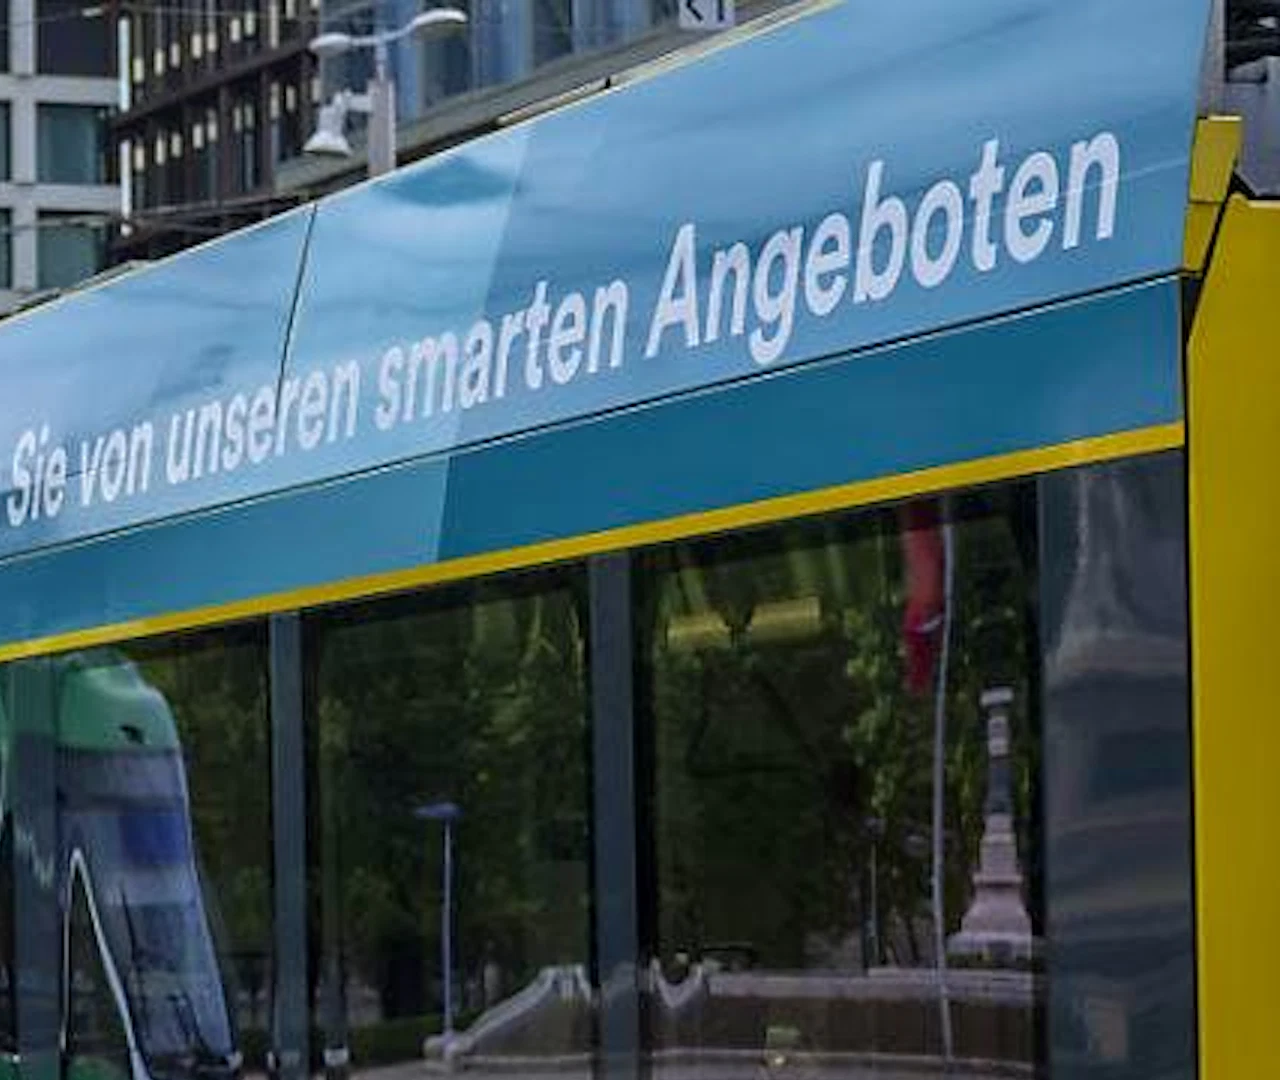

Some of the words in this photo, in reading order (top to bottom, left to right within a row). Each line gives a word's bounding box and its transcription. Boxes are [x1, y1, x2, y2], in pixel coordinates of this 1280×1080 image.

[6, 423, 67, 528] Sie
[80, 418, 155, 506] von
[165, 358, 361, 485] unseren
[373, 278, 628, 431] smarten
[644, 131, 1121, 365] Angeboten
